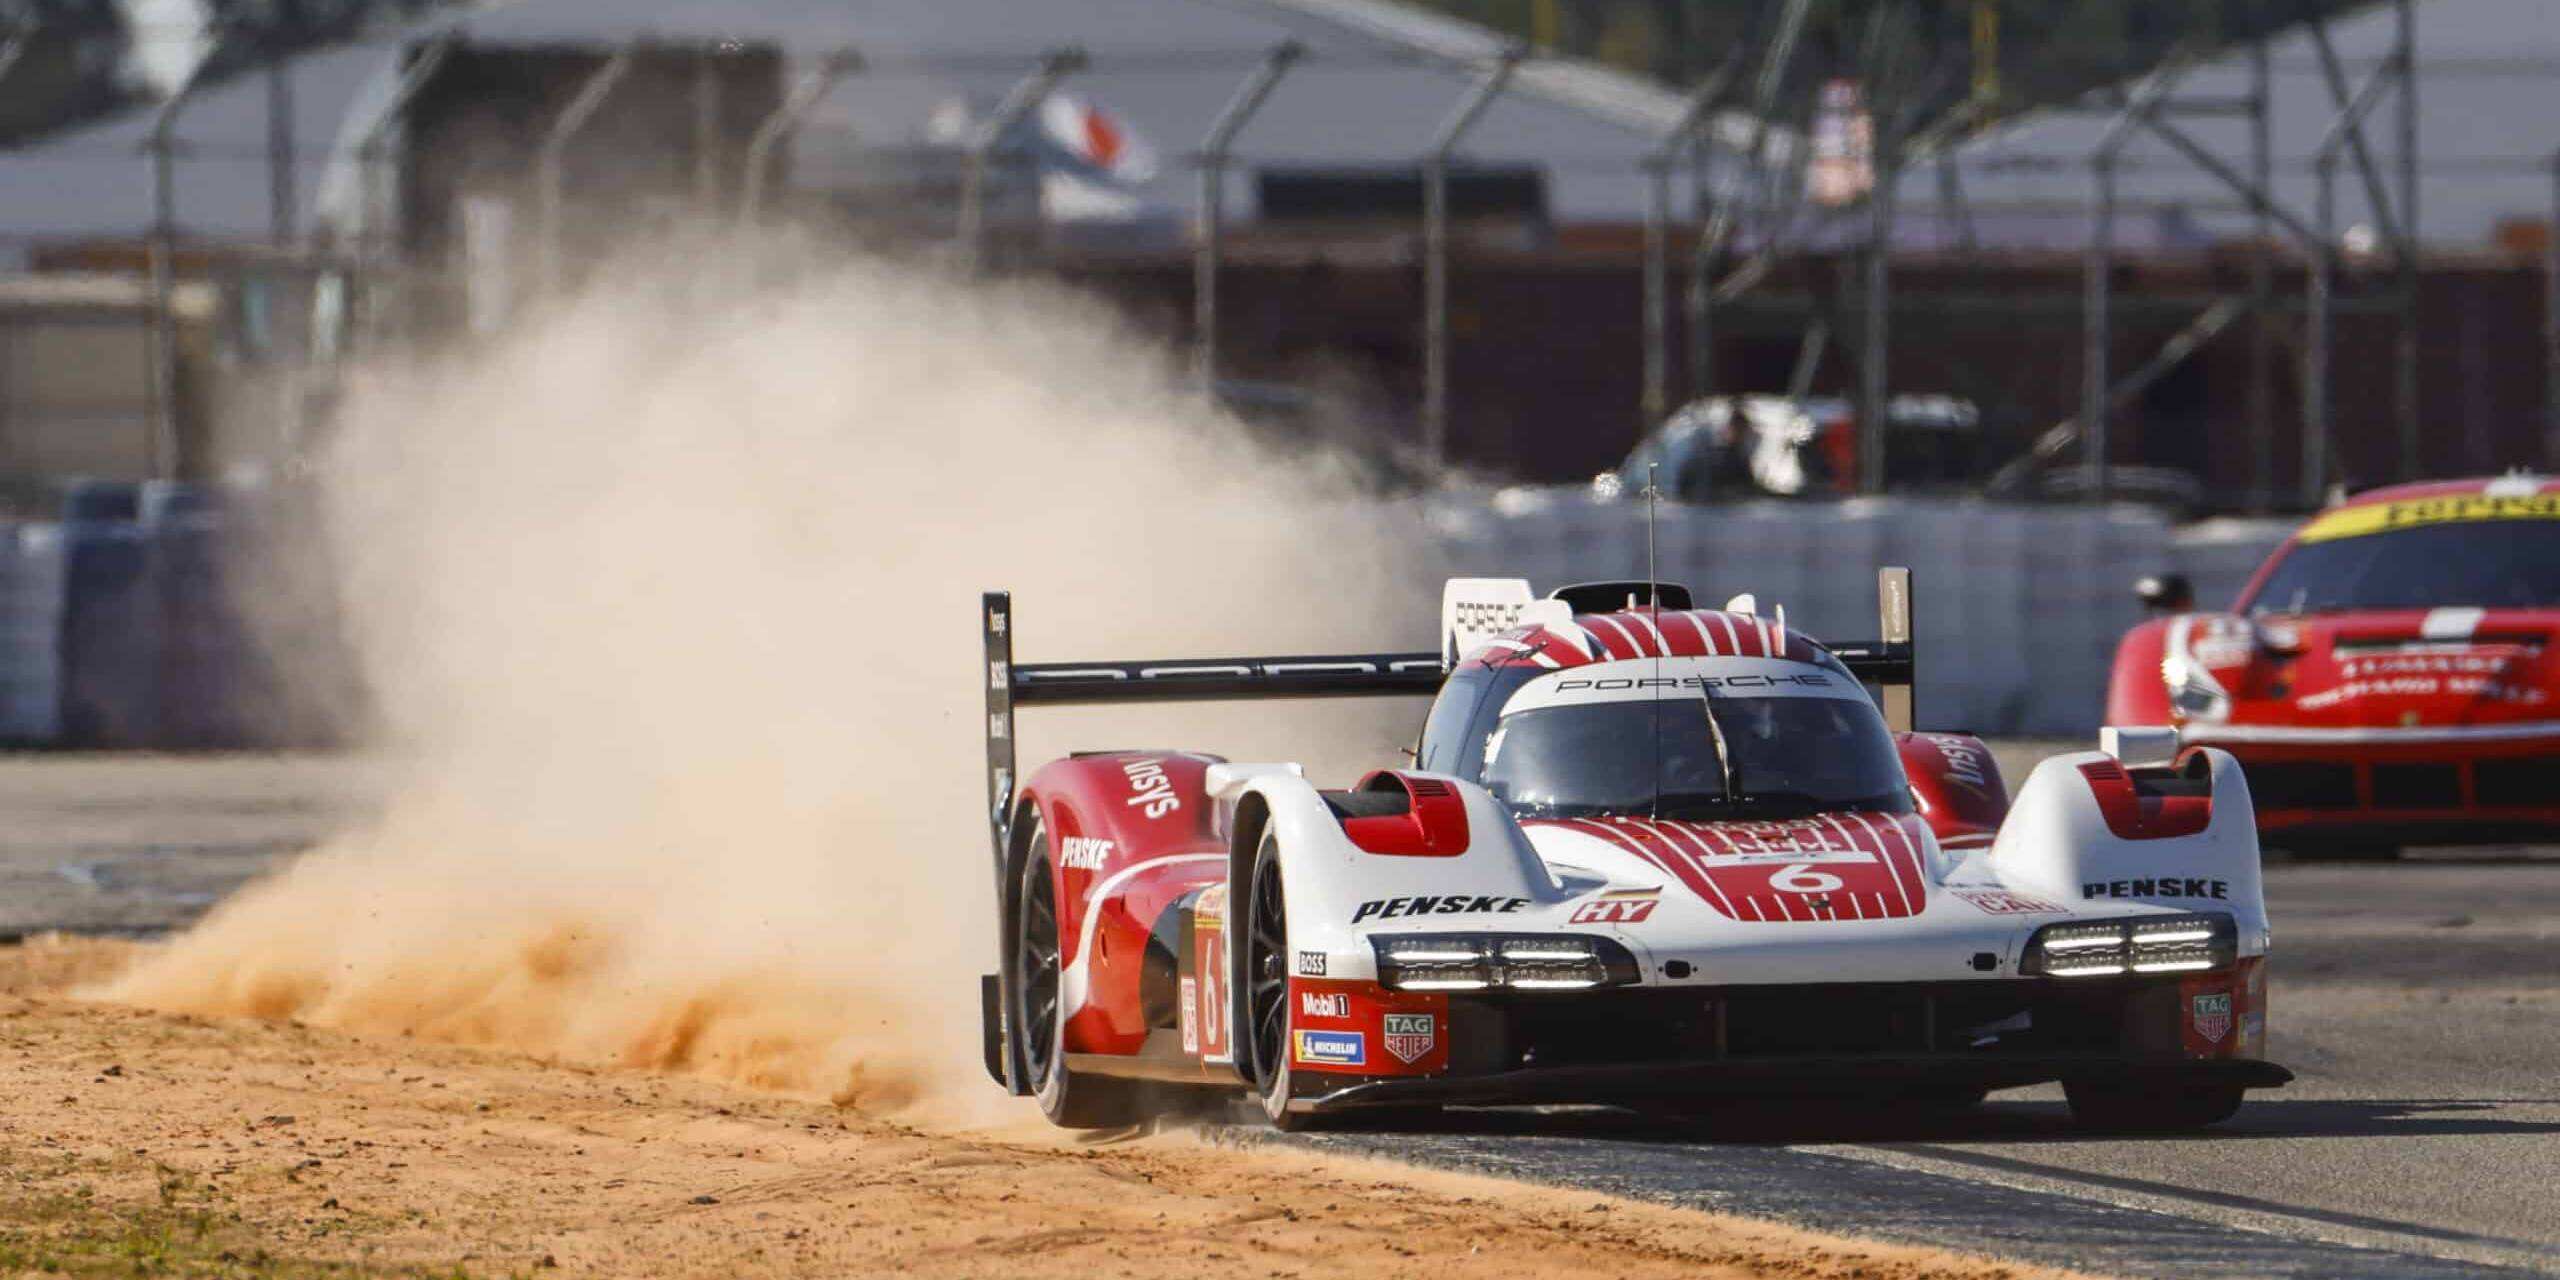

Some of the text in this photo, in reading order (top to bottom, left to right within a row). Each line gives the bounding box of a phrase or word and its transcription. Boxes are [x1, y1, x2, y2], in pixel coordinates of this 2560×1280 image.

[1556, 674, 1832, 693] PORSCHE
[1060, 836, 1114, 870] PENSKE
[1769, 864, 1843, 892] 6
[2083, 878, 2228, 900] PENSKE
[1351, 896, 1531, 924] PENSKE
[1574, 900, 1656, 922] HY
[1301, 953, 1324, 974] BOSS
[1204, 938, 1217, 1045] 6
[1302, 992, 1335, 1016] Mobil
[2198, 998, 2229, 1013] TAG
[1388, 1018, 1428, 1032] TAG
[1314, 1041, 1357, 1056] MICHELIN
[1387, 1036, 1428, 1059] HEUER
